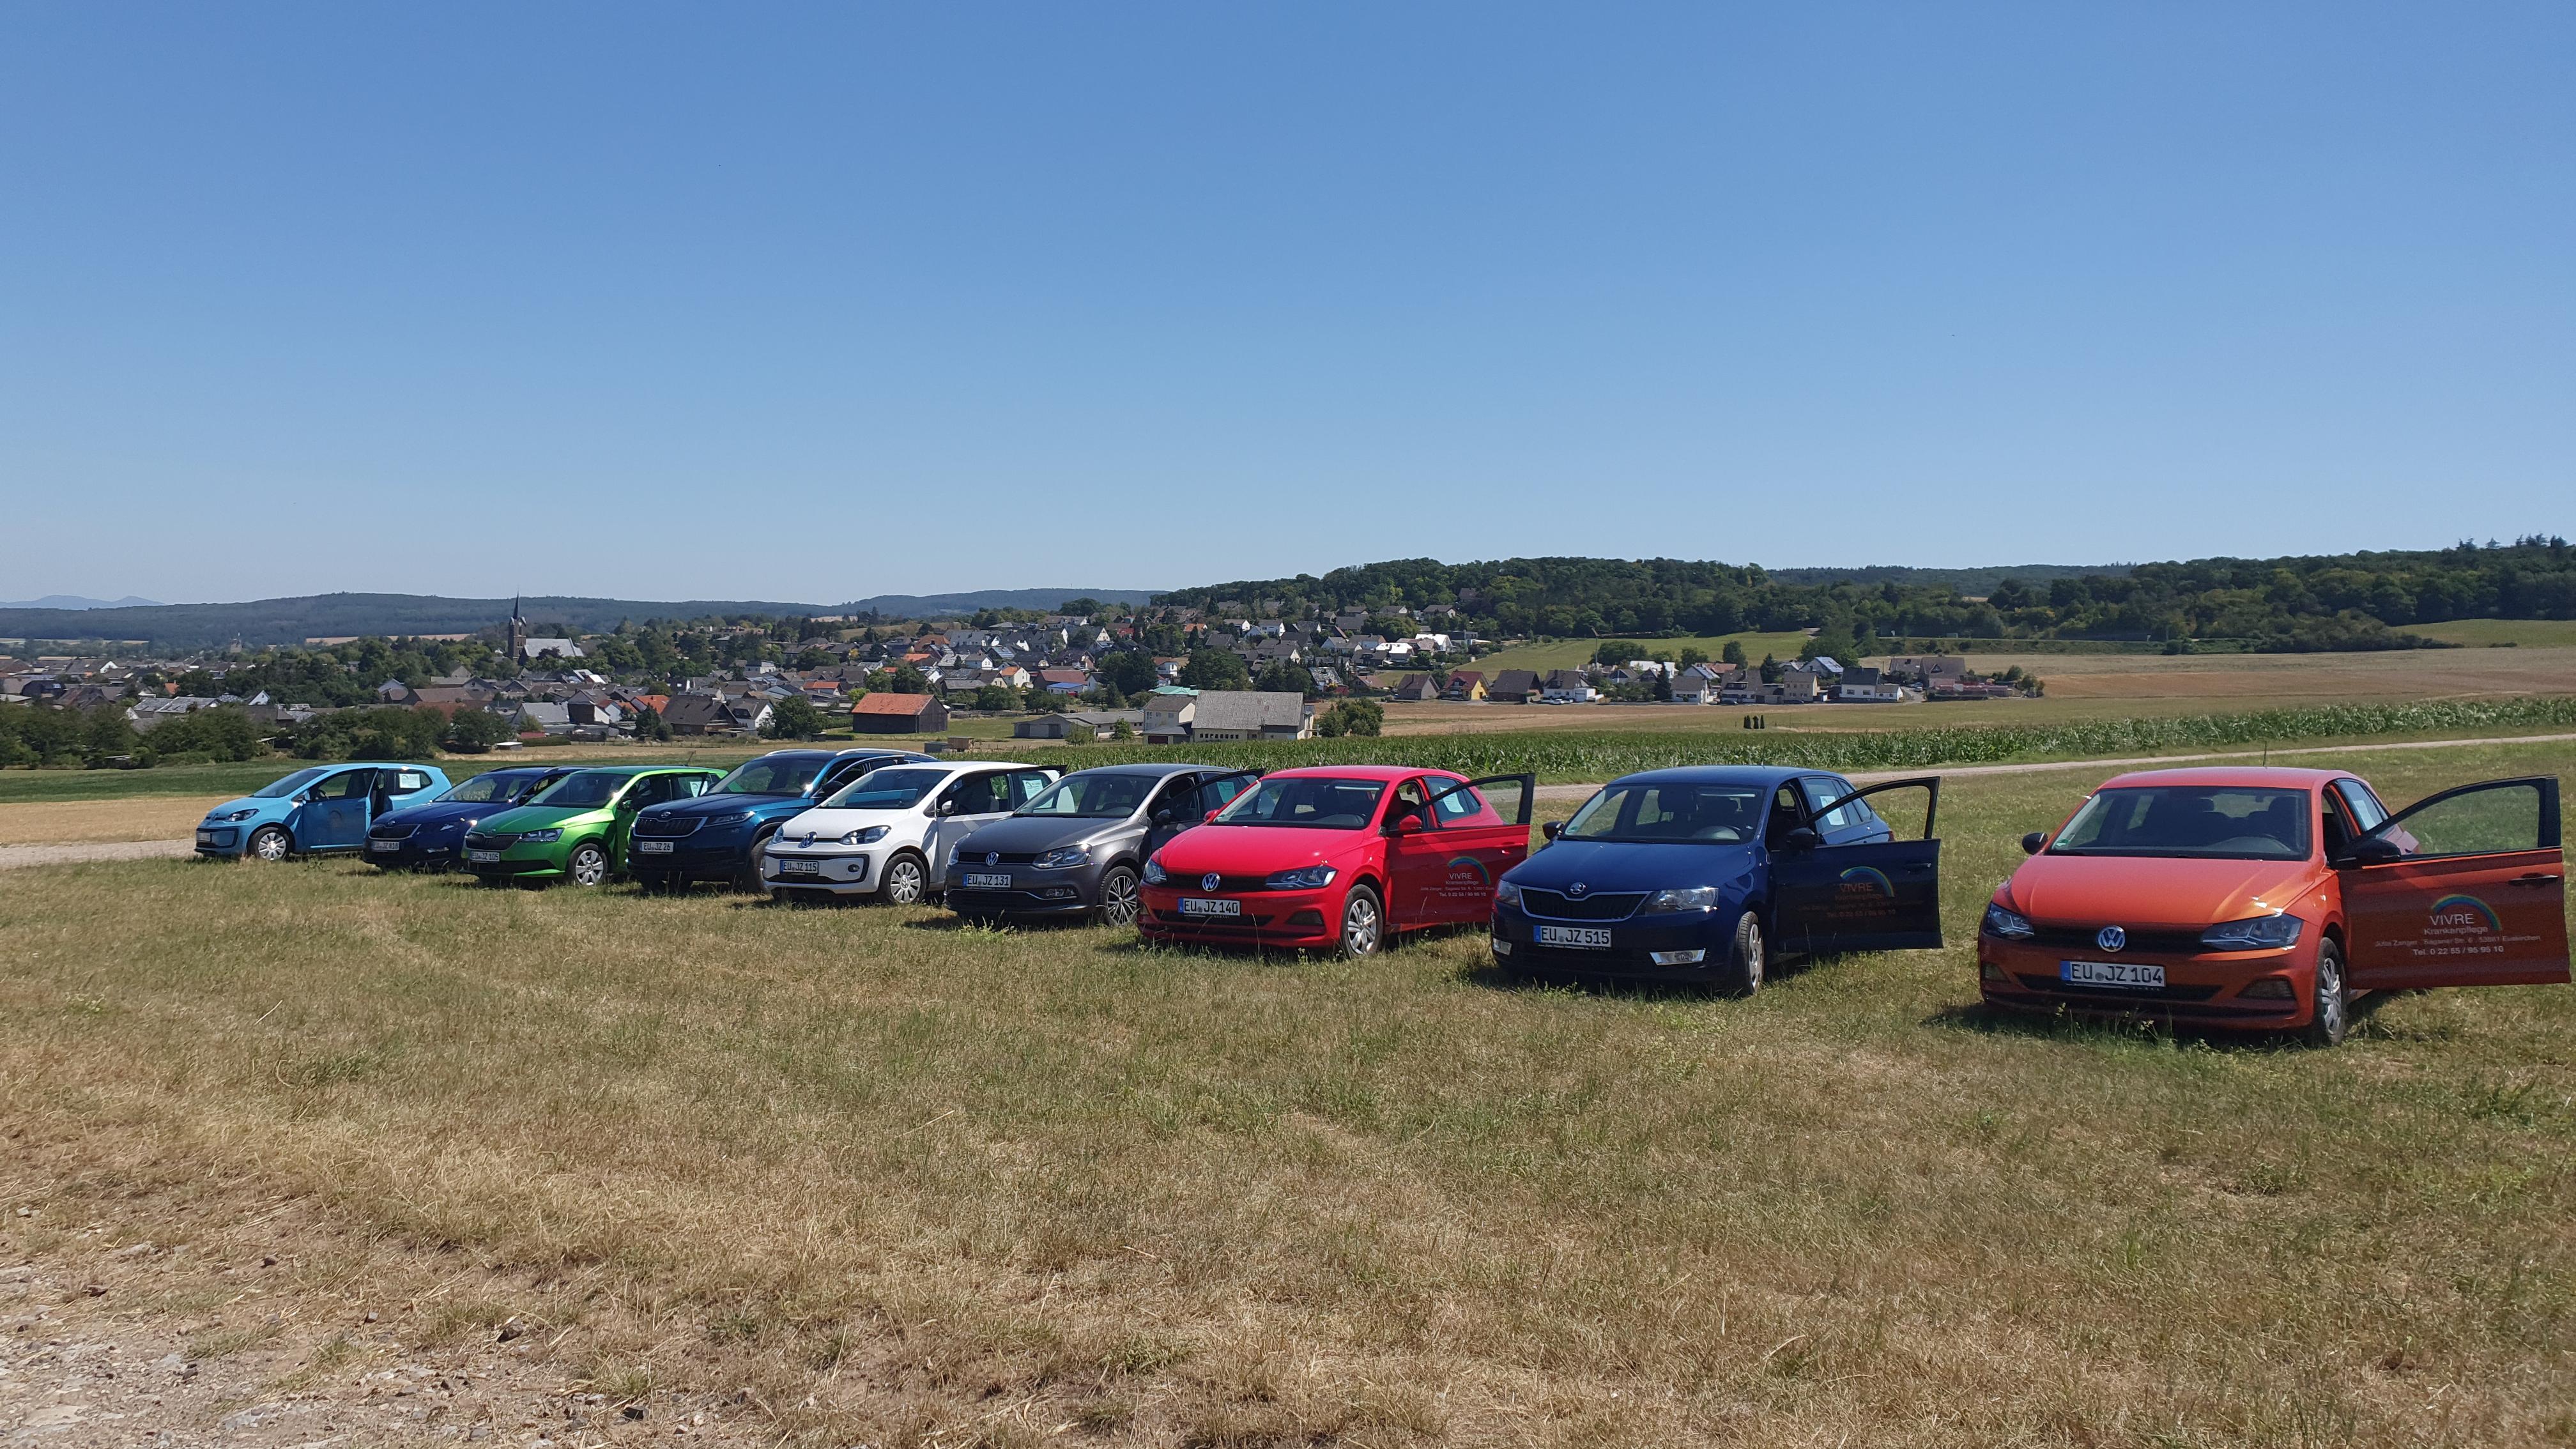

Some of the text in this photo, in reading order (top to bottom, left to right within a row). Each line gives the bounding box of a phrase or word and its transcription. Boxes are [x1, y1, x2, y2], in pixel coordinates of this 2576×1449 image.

[784, 862, 816, 871] EU JZ 115
[967, 875, 1009, 886] EU JZ 131
[1184, 900, 1238, 914] EU JZ 140
[2430, 913, 2475, 926] VIVRE
[1541, 928, 1609, 944] EU JZ 515
[2423, 926, 2488, 936] Krankenpflege
[2071, 963, 2163, 984] EU JZ 104
